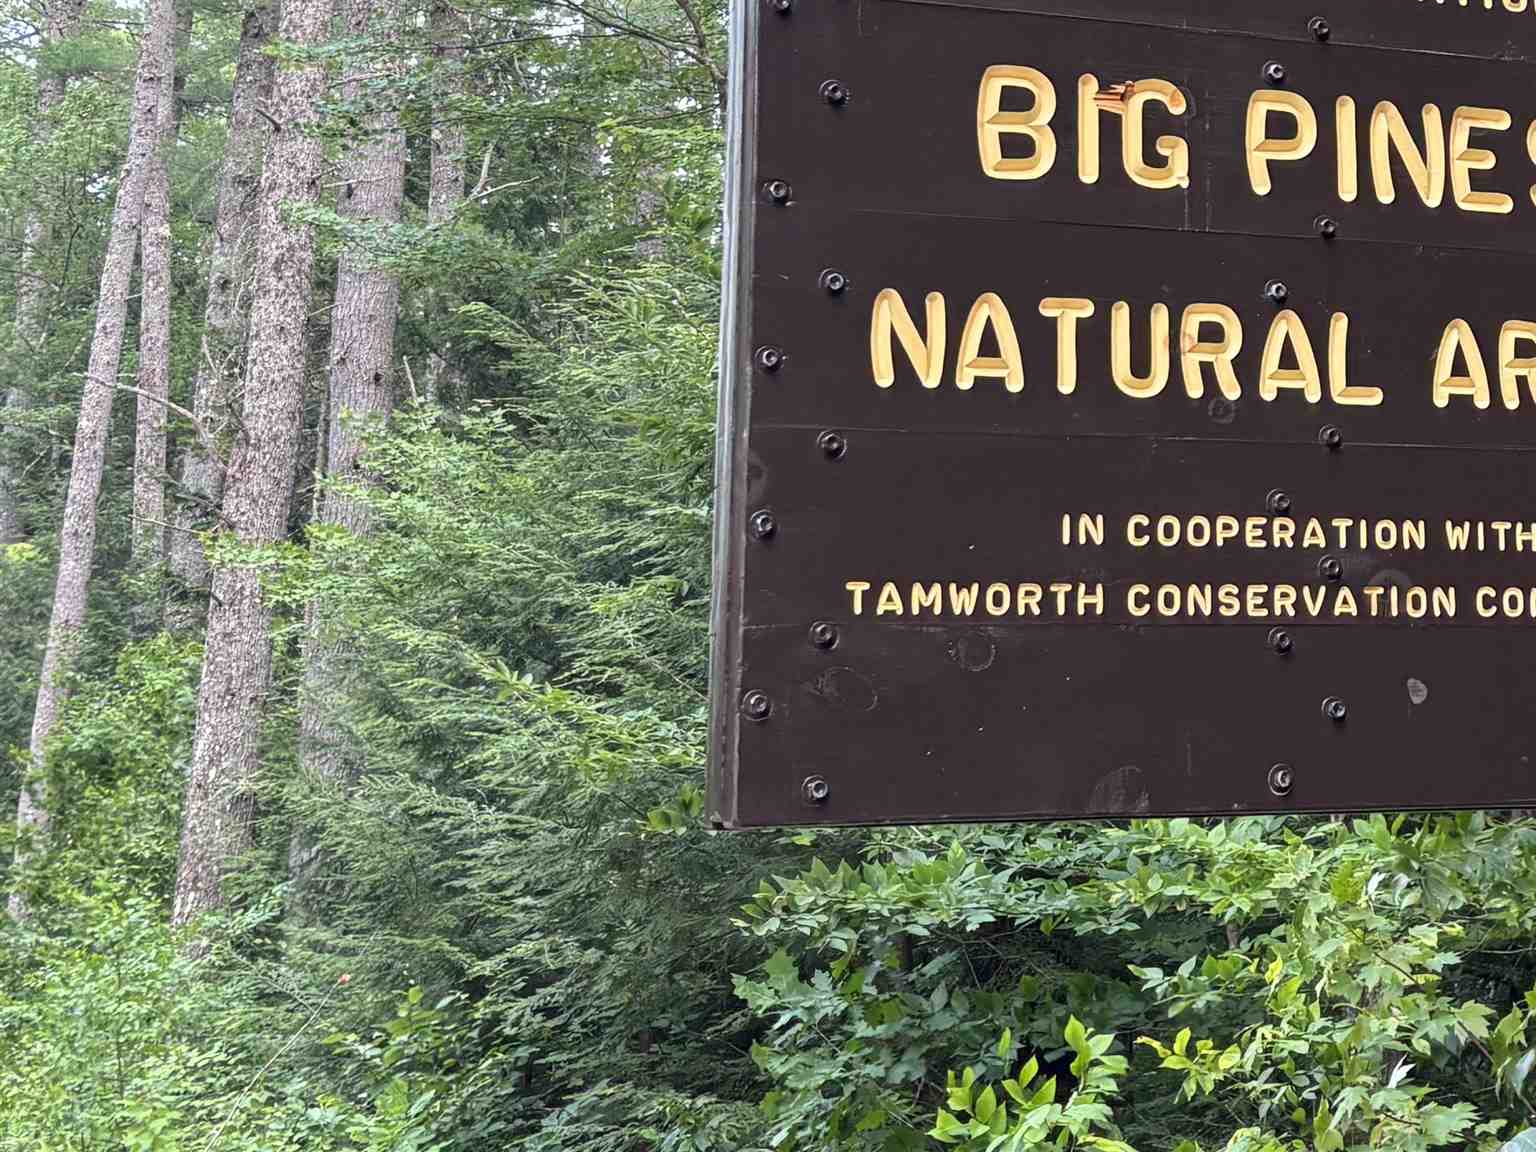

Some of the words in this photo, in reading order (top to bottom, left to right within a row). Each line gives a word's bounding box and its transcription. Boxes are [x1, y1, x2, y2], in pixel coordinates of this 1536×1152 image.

[974, 62, 1191, 190] BIG
[868, 286, 1385, 407] NATURAL
[1061, 512, 1105, 547] IN
[1125, 513, 1427, 551] COOPERATION
[844, 580, 1105, 617] TAMWORTH
[1126, 582, 1457, 619] CONSERVATION
